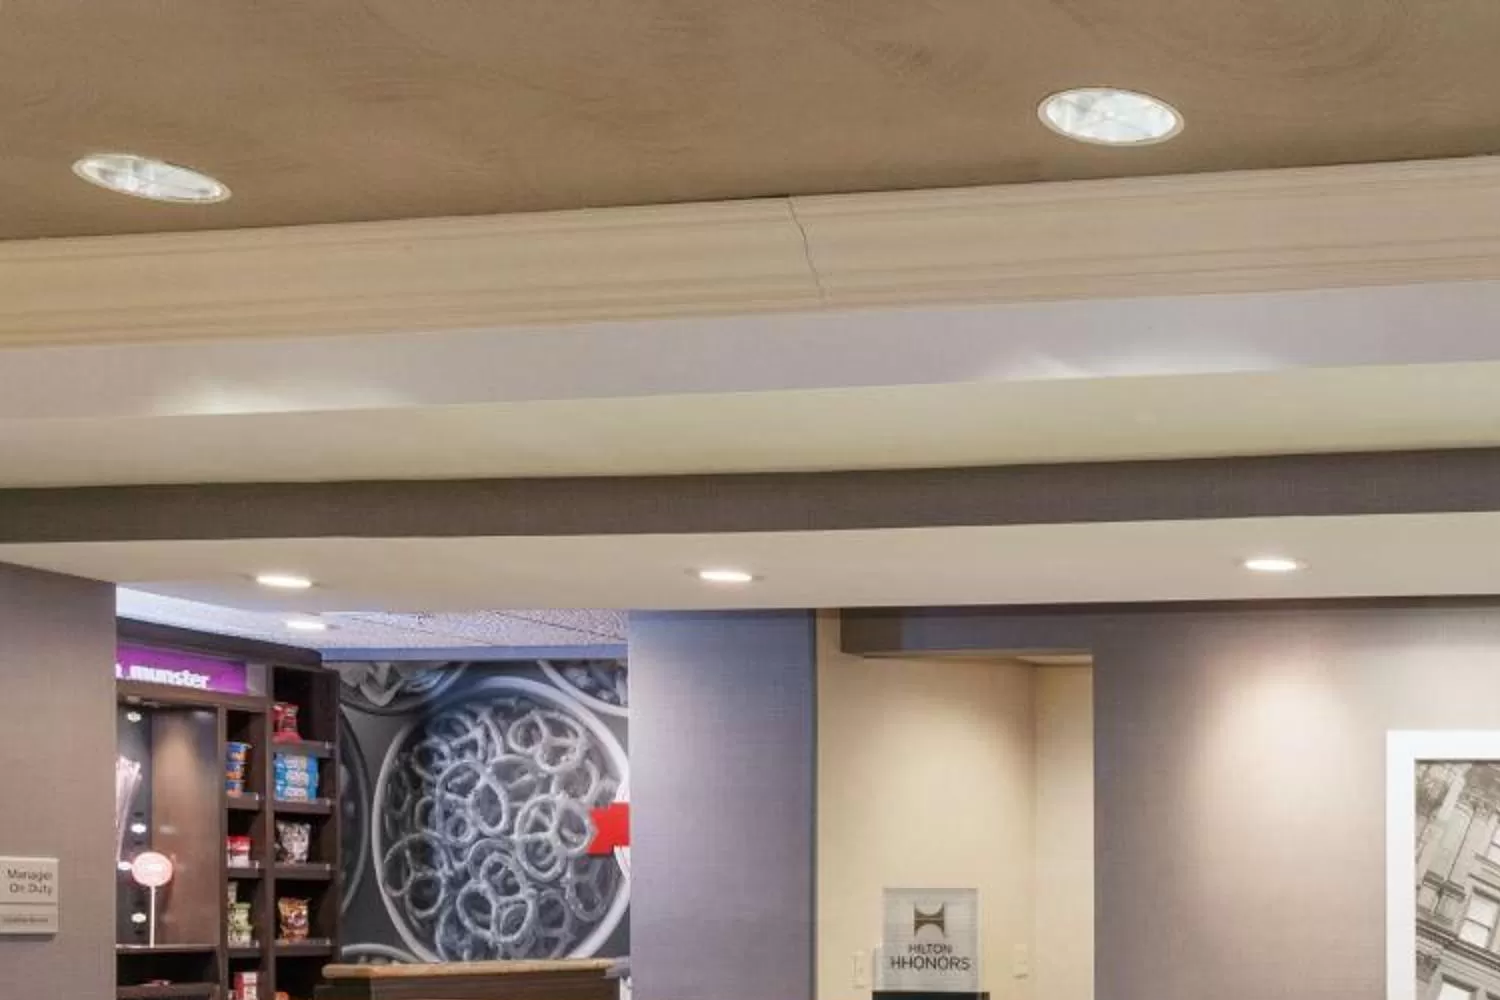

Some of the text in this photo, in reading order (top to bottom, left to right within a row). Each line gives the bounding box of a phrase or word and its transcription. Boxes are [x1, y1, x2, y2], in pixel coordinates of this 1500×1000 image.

[7, 868, 54, 883] Manager
[27, 883, 54, 897] Duty
[908, 943, 953, 955] HILTON
[889, 955, 971, 971] HHONORS
